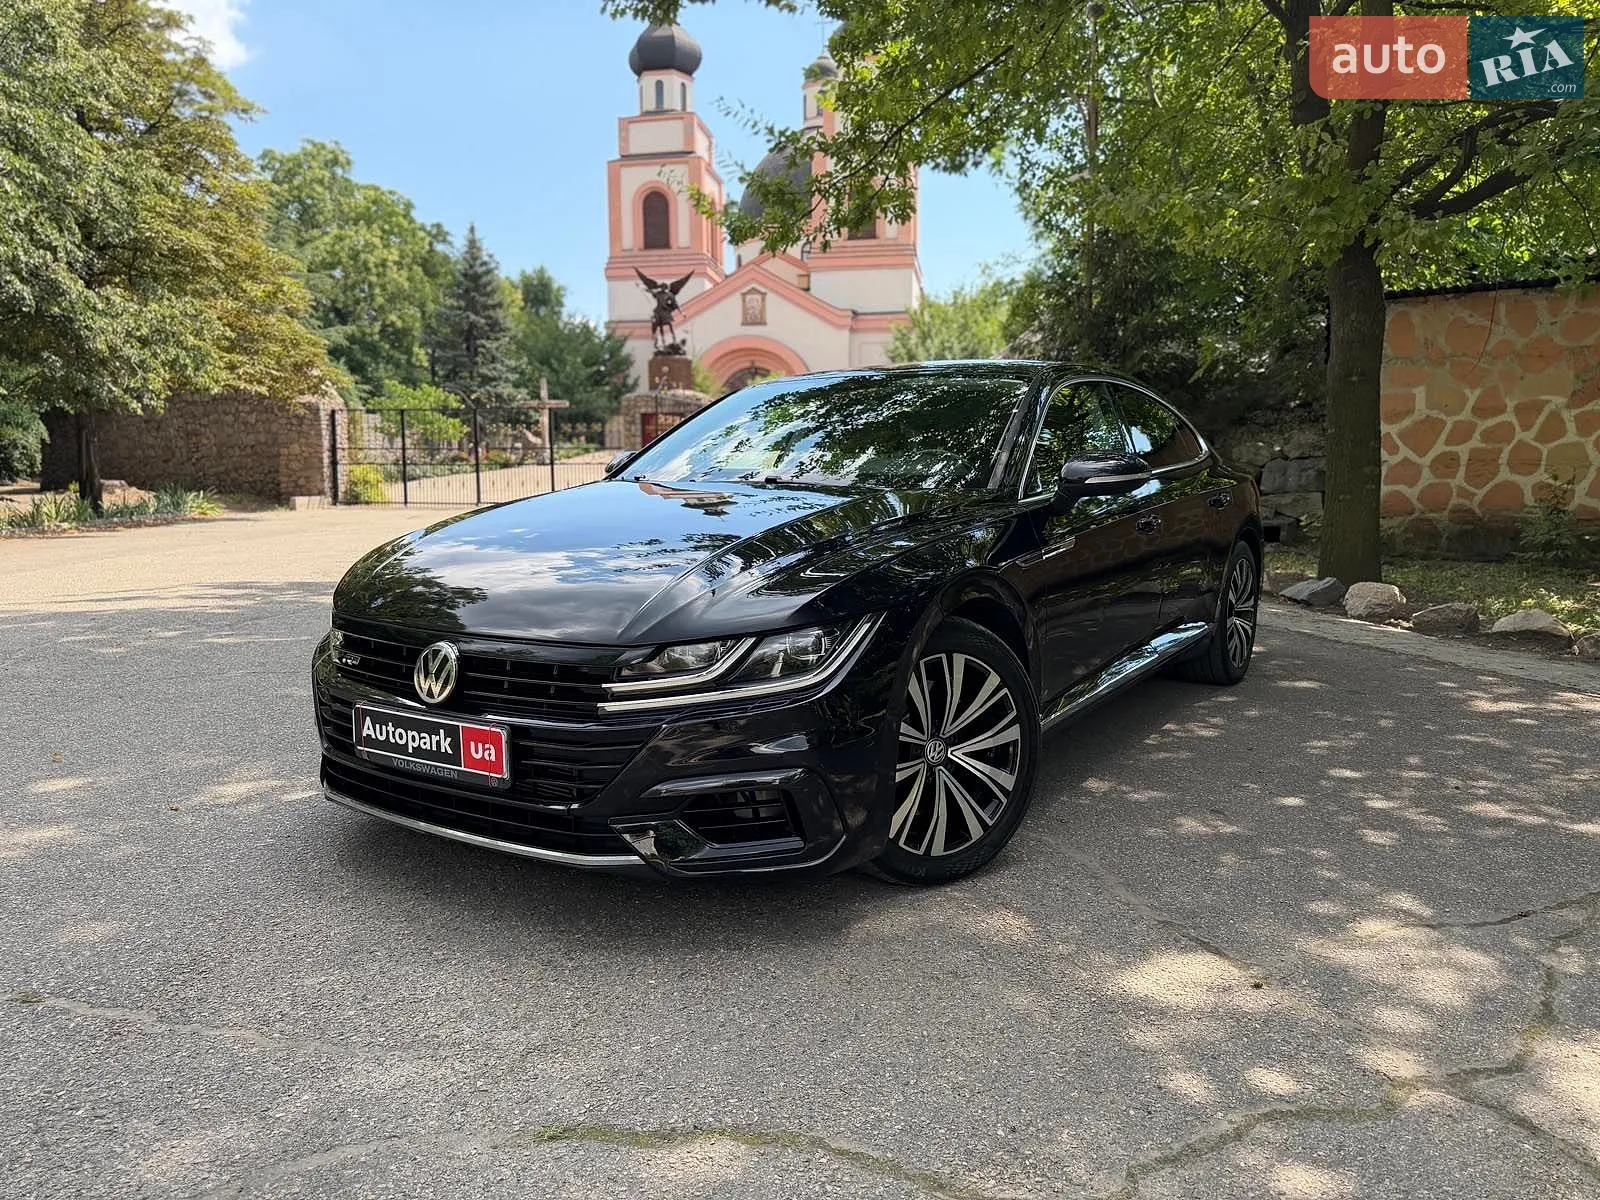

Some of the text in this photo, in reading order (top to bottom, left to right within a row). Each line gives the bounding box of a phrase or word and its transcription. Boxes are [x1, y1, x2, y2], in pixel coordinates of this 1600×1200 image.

[362, 715, 496, 762] Autopark ua
[392, 757, 458, 779] VOLKSWAGEN
